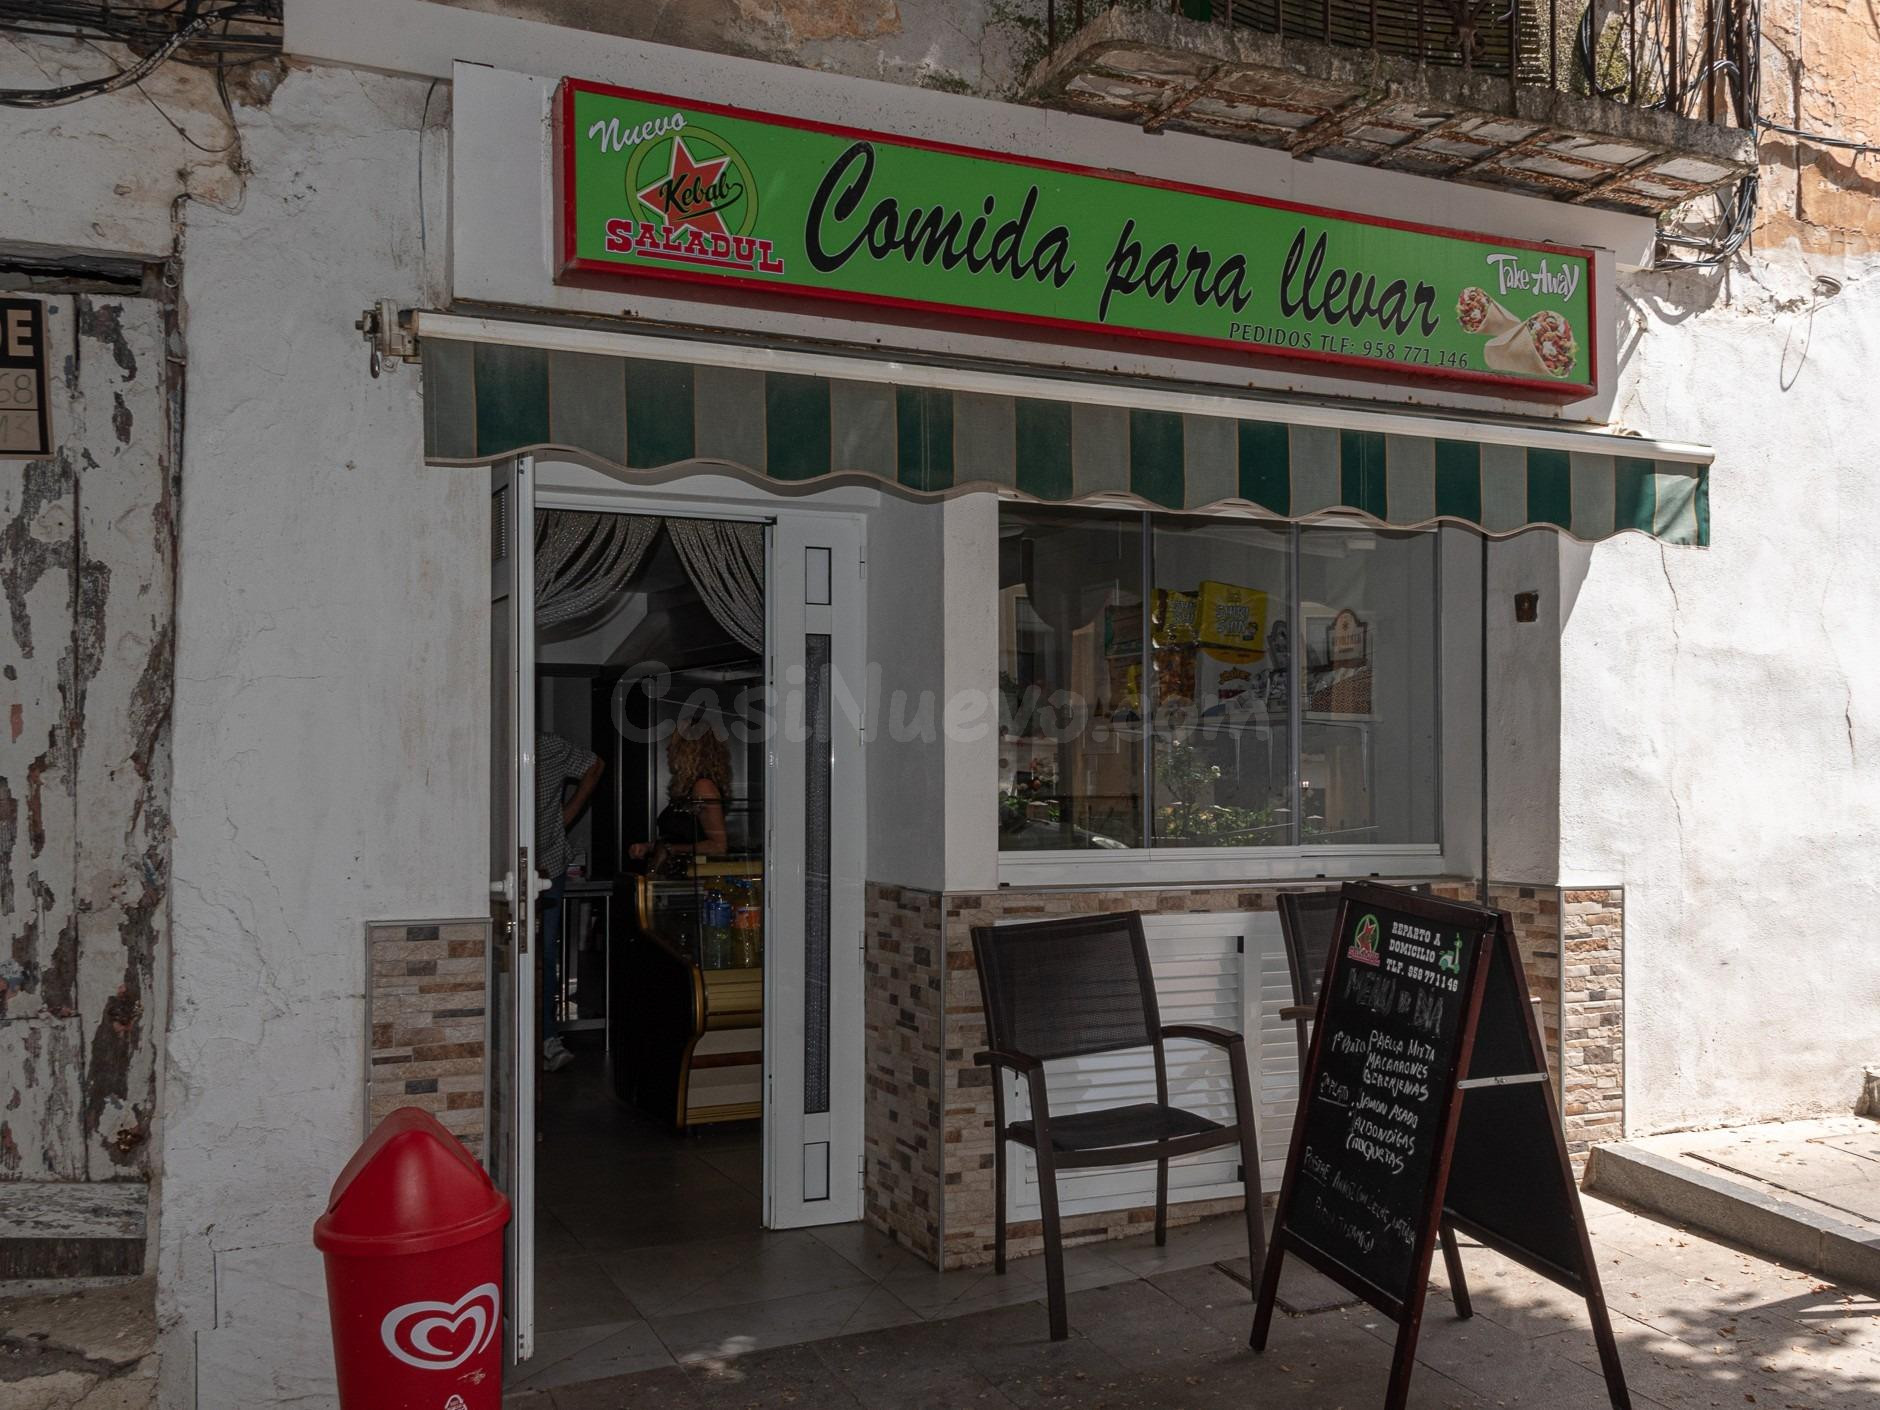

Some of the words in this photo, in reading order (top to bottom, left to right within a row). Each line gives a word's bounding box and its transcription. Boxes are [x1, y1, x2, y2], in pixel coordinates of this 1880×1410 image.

[589, 112, 687, 152] Nuevo
[659, 171, 744, 219] Kebab
[605, 218, 785, 275] SALADUL
[805, 140, 1076, 288] Comida
[1099, 218, 1252, 322] para
[1280, 226, 1440, 337] llevar
[1486, 253, 1530, 296] Take
[1229, 322, 1312, 349] PEDIDOS
[1320, 335, 1356, 355] TLF:
[1363, 341, 1396, 360] 958
[1403, 346, 1431, 365] 771
[1438, 350, 1468, 369] 146
[1389, 939, 1436, 963] DOMICILIO
[1392, 922, 1431, 943] REPARTO
[1434, 933, 1441, 946] A
[1386, 958, 1404, 976] TLF.
[1367, 1030, 1403, 1053] PAELLA
[1366, 1052, 1428, 1078] MACARRONES
